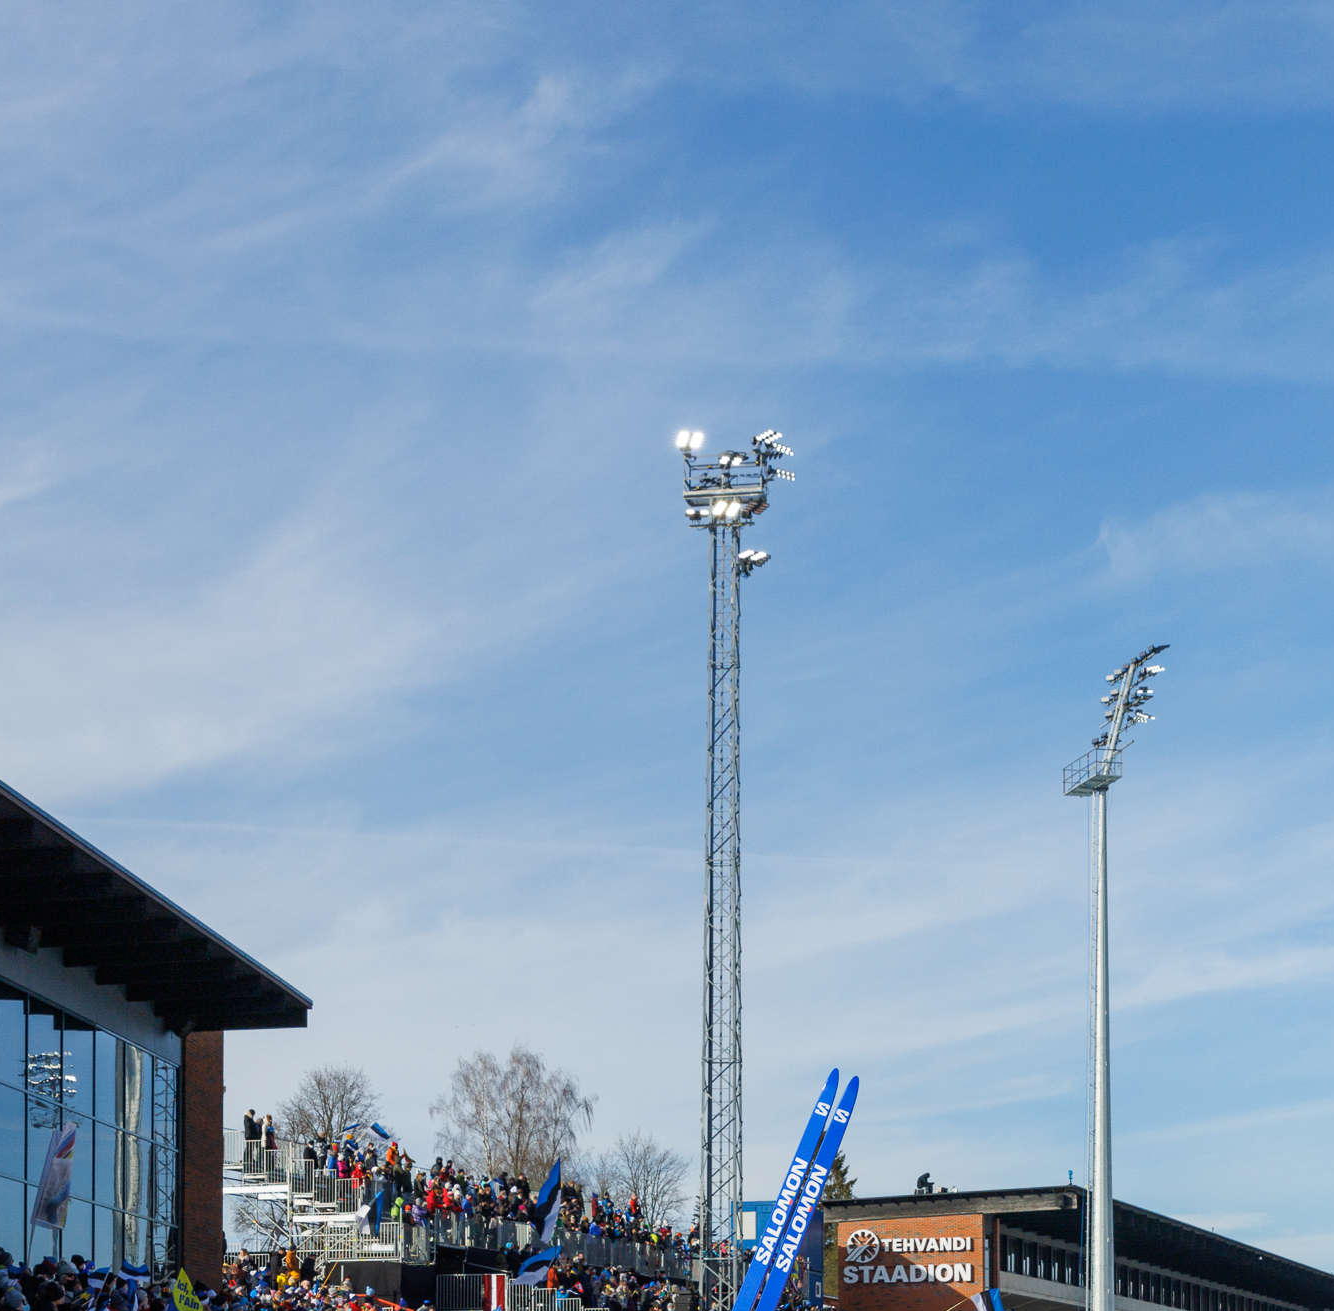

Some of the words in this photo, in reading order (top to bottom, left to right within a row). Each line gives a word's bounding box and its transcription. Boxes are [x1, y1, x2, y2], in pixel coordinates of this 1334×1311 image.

[755, 1156, 808, 1266] SALOMON
[775, 1164, 828, 1274] SALOMON
[844, 1262, 972, 1285] STAADION
[881, 1236, 973, 1254] TEHVANDI
